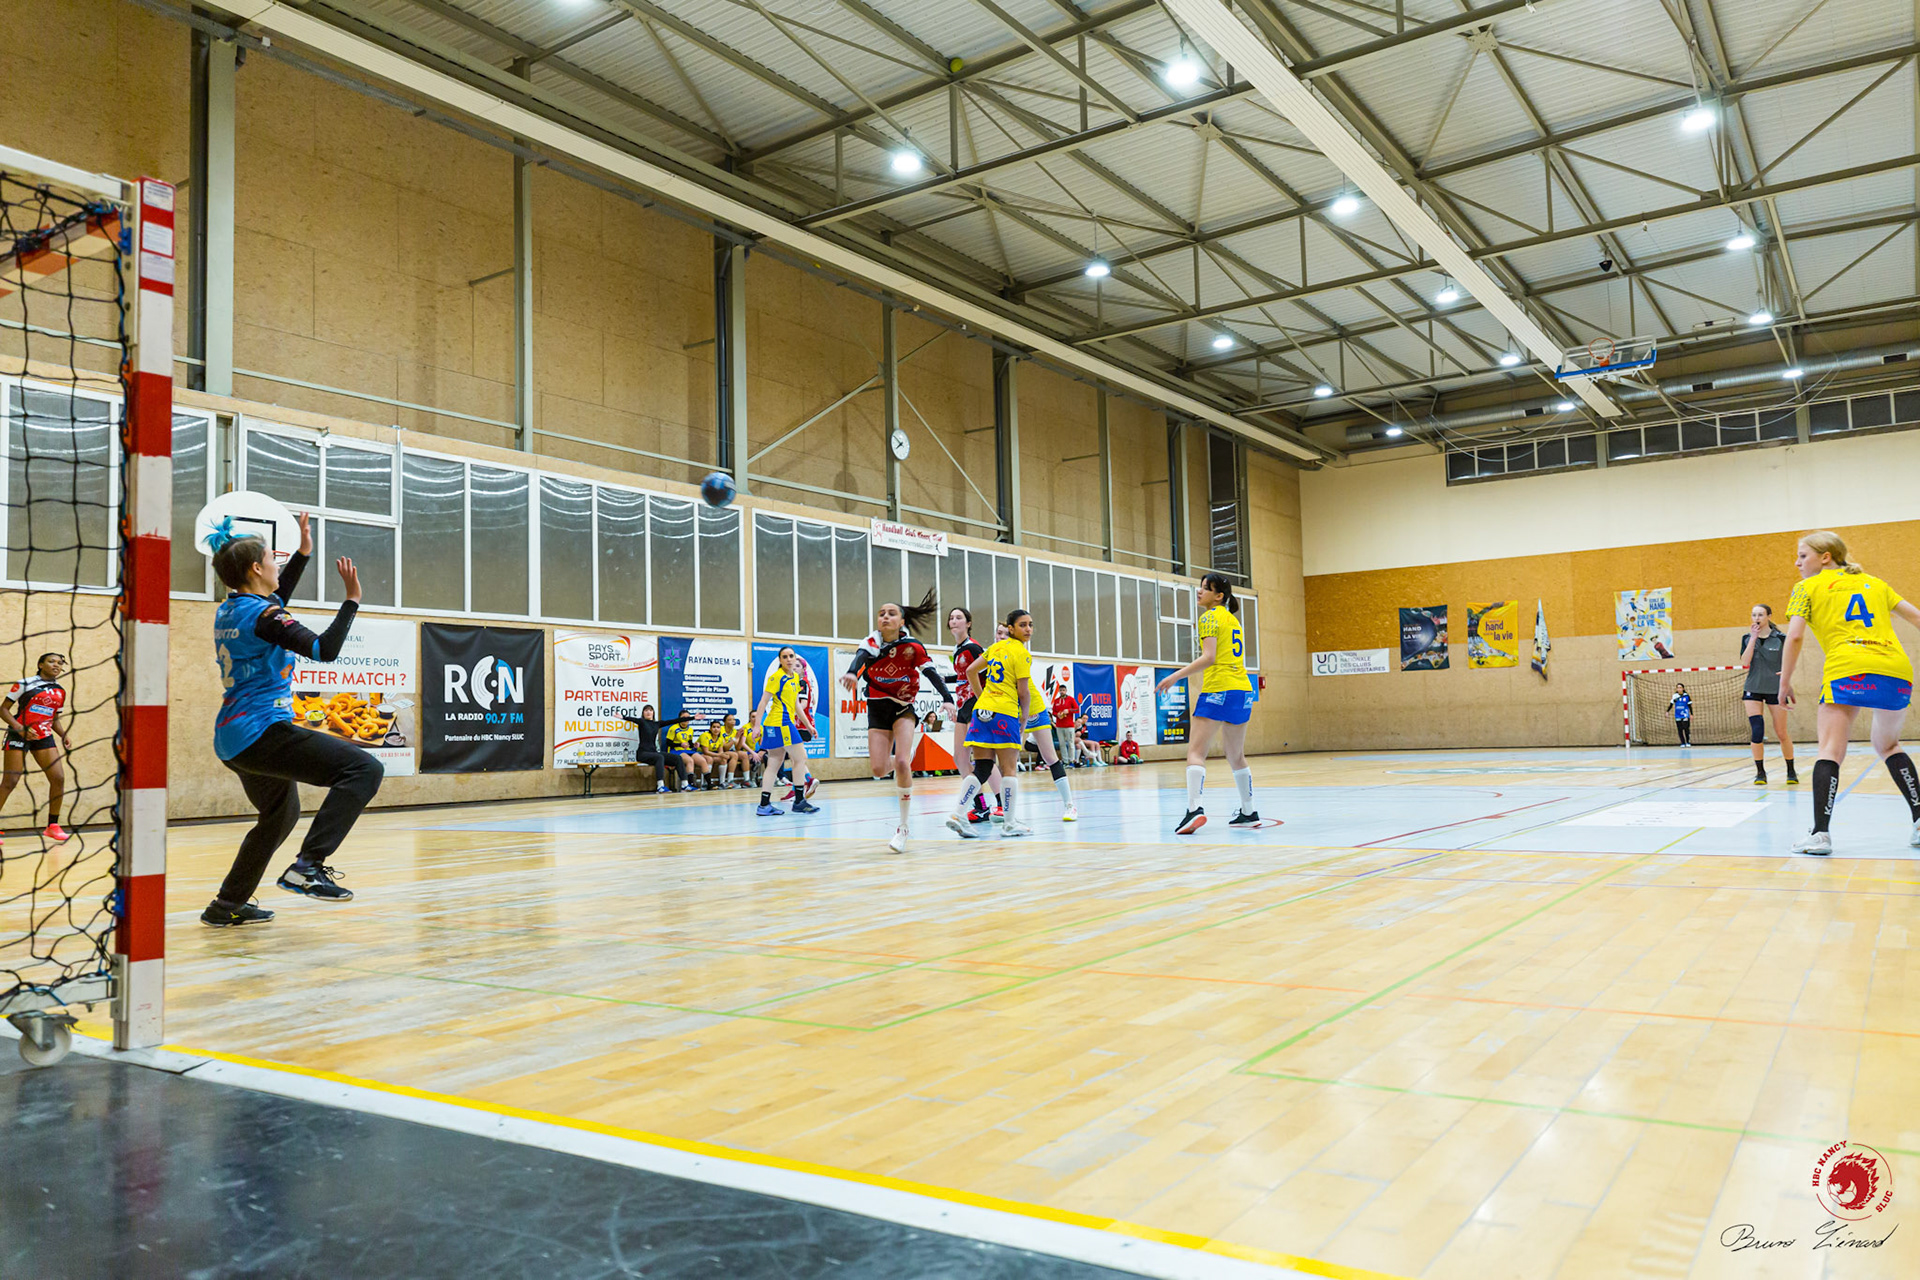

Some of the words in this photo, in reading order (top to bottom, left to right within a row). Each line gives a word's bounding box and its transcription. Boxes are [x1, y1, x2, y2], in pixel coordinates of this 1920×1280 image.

[1649, 601, 1665, 610] HAND
[1844, 593, 1875, 628] 4
[1485, 620, 1504, 631] hand
[1493, 631, 1501, 641] la
[1502, 630, 1513, 640] vie
[588, 644, 614, 653] PAYS
[1232, 629, 1243, 658] 5
[588, 652, 621, 661] SPORT
[888, 646, 897, 659] 9
[373, 658, 399, 667] POUR
[688, 656, 713, 664] RAYAN
[714, 657, 730, 665] DEM
[731, 658, 741, 666] 54
[985, 658, 1005, 684] 13
[341, 671, 396, 686] MATCH
[591, 675, 625, 688] Votre
[1839, 683, 1877, 691] VEOLIA
[564, 690, 649, 703] PARTENAIRE
[1091, 693, 1112, 704] INTER
[577, 706, 593, 717] de
[1091, 705, 1113, 719] SPORT
[457, 713, 484, 721] RADIO
[485, 713, 507, 724] 90.7
[509, 712, 524, 724] FM
[960, 784, 976, 806] Kempa
[1004, 787, 1012, 812] Kempa
[1824, 776, 1838, 816] Kempa
